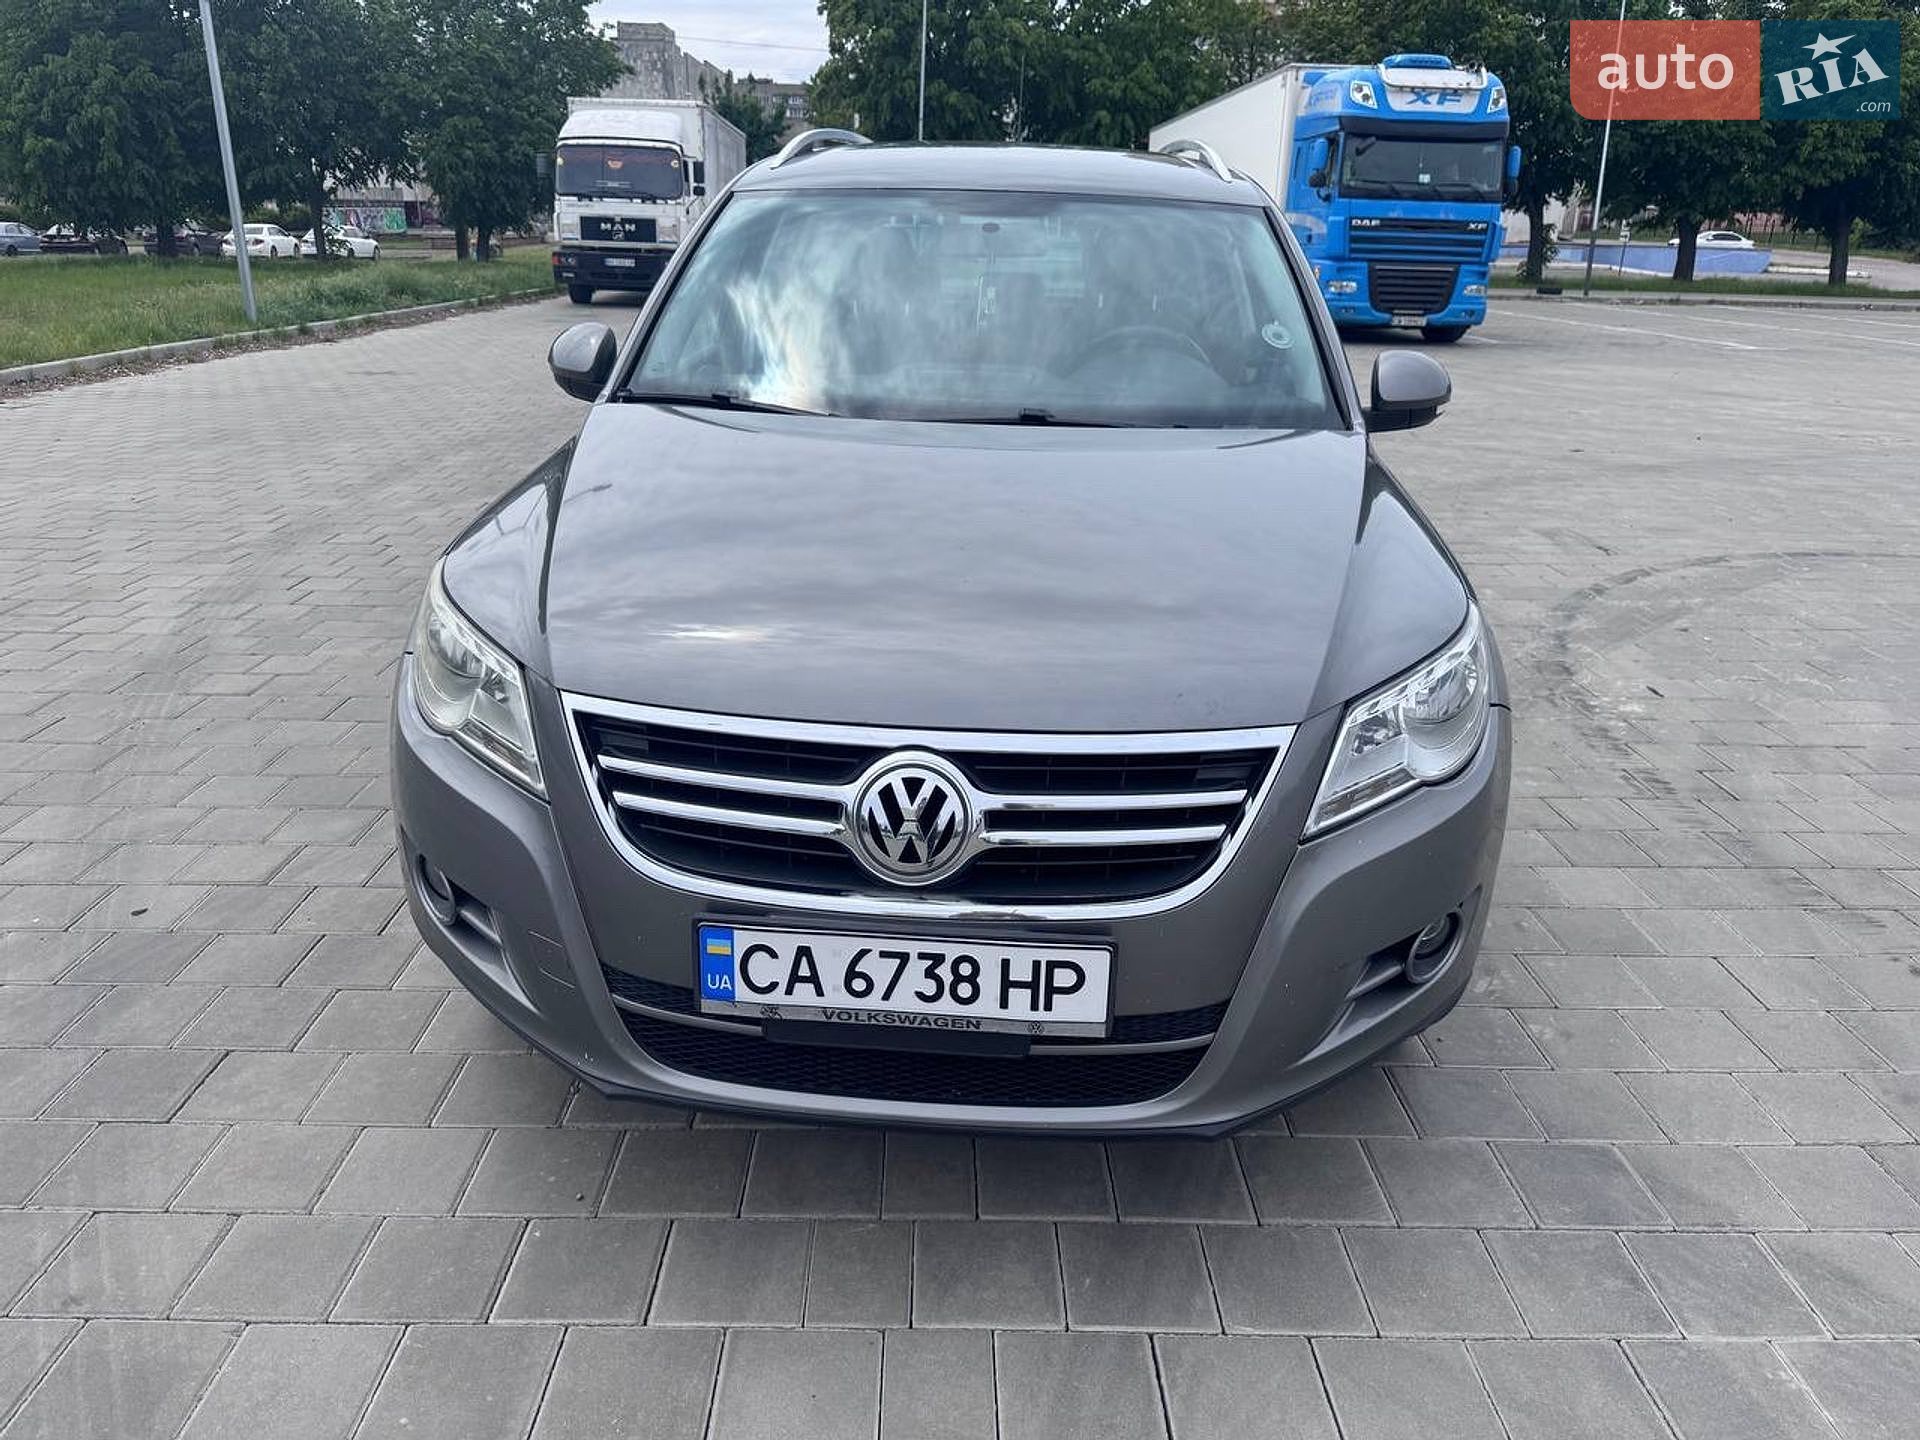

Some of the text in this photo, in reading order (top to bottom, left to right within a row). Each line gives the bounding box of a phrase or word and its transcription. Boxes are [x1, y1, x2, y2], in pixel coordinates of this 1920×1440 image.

[1406, 88, 1463, 105] XF
[600, 222, 636, 232] MAN
[1351, 219, 1381, 227] DAF
[1467, 222, 1488, 231] XF
[707, 973, 732, 990] UA
[739, 943, 1087, 1013] CA 6738 HP
[822, 1008, 983, 1030] VOLKSWAGEN
